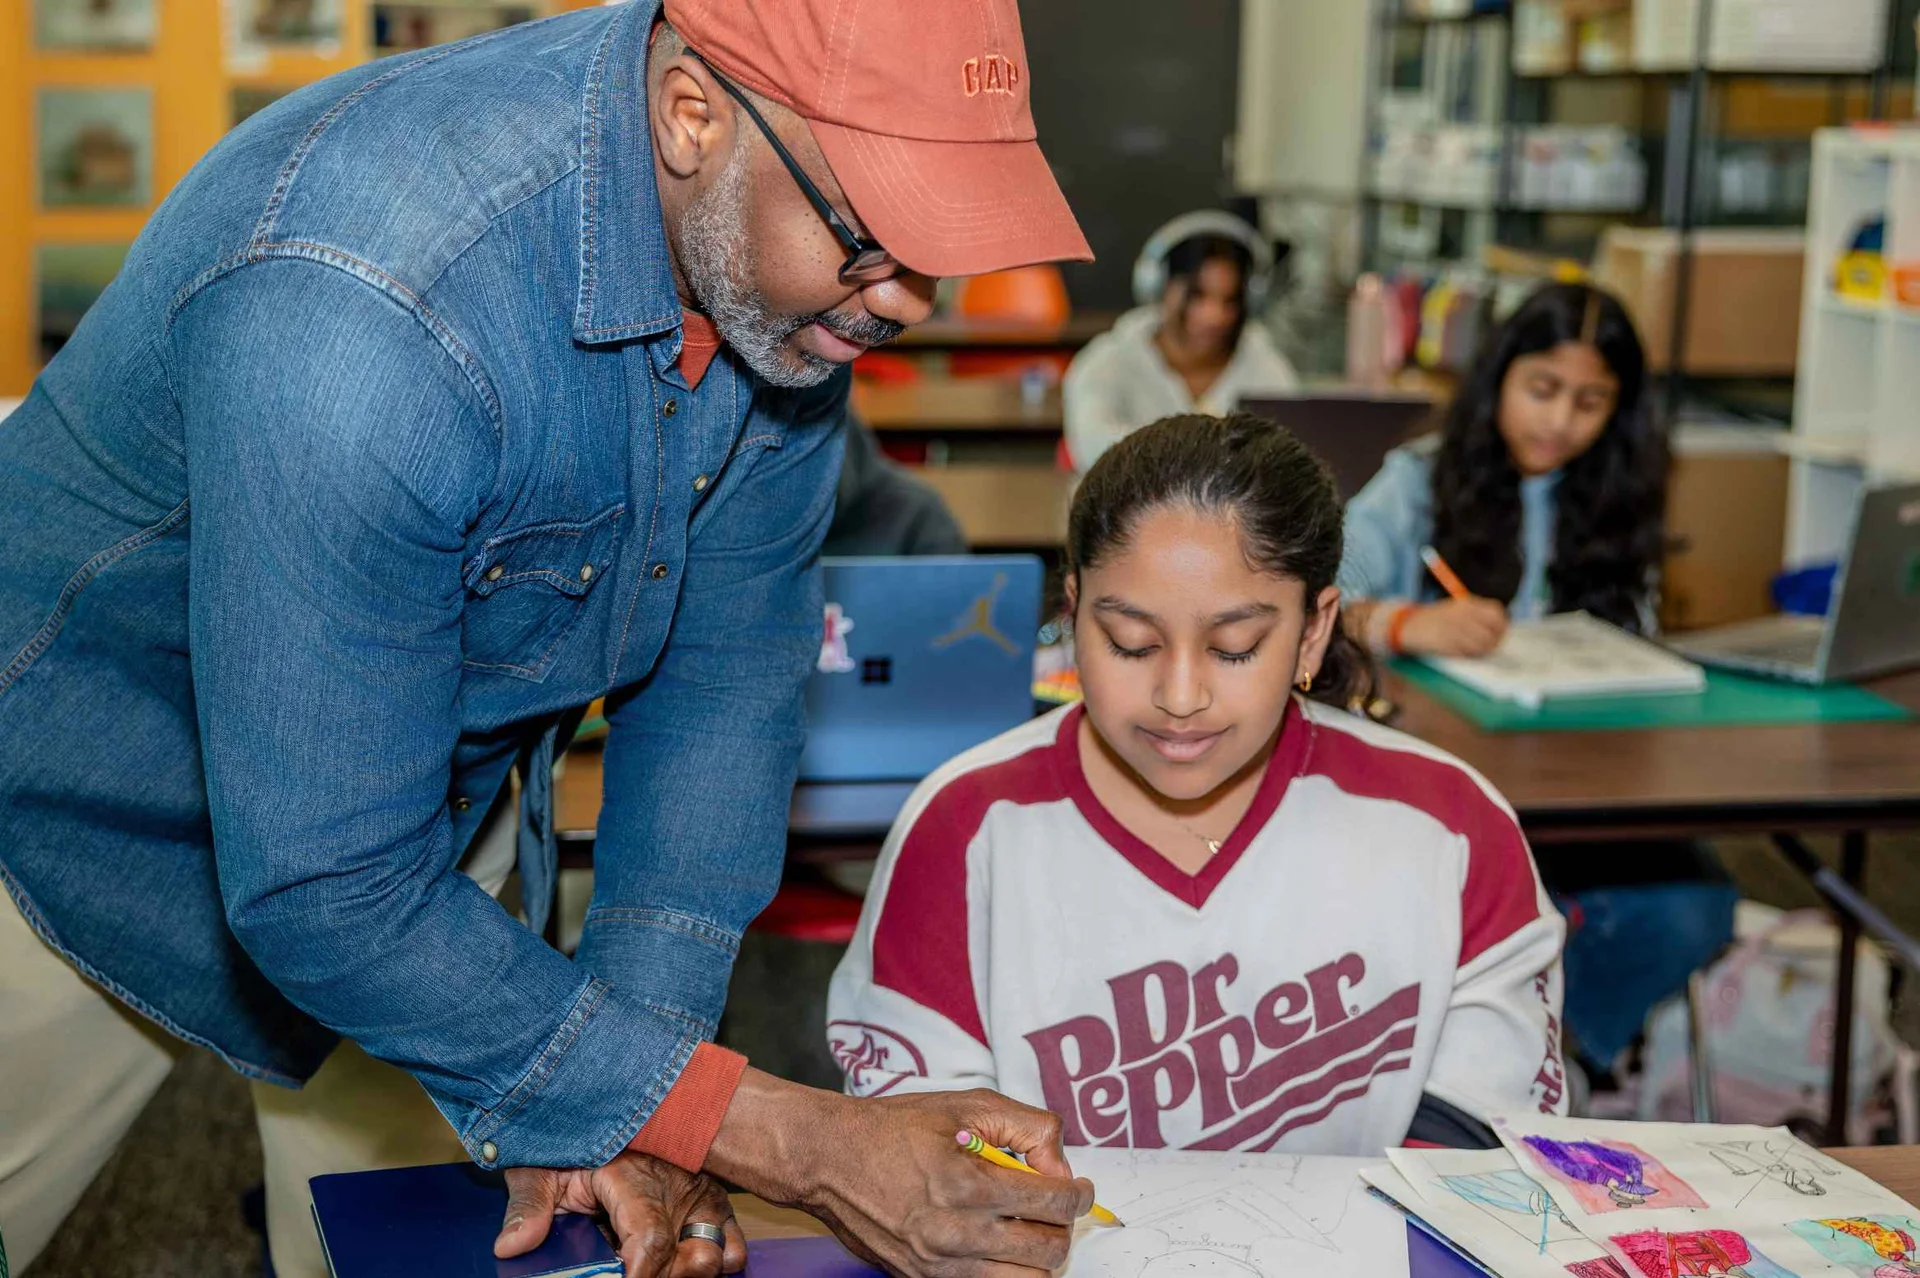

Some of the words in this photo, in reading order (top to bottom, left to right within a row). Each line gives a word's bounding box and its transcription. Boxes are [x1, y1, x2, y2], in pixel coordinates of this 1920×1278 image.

[962, 54, 1018, 97] GAP
[1022, 952, 1366, 1149] Pepper
[1106, 952, 1239, 1066] Dr
